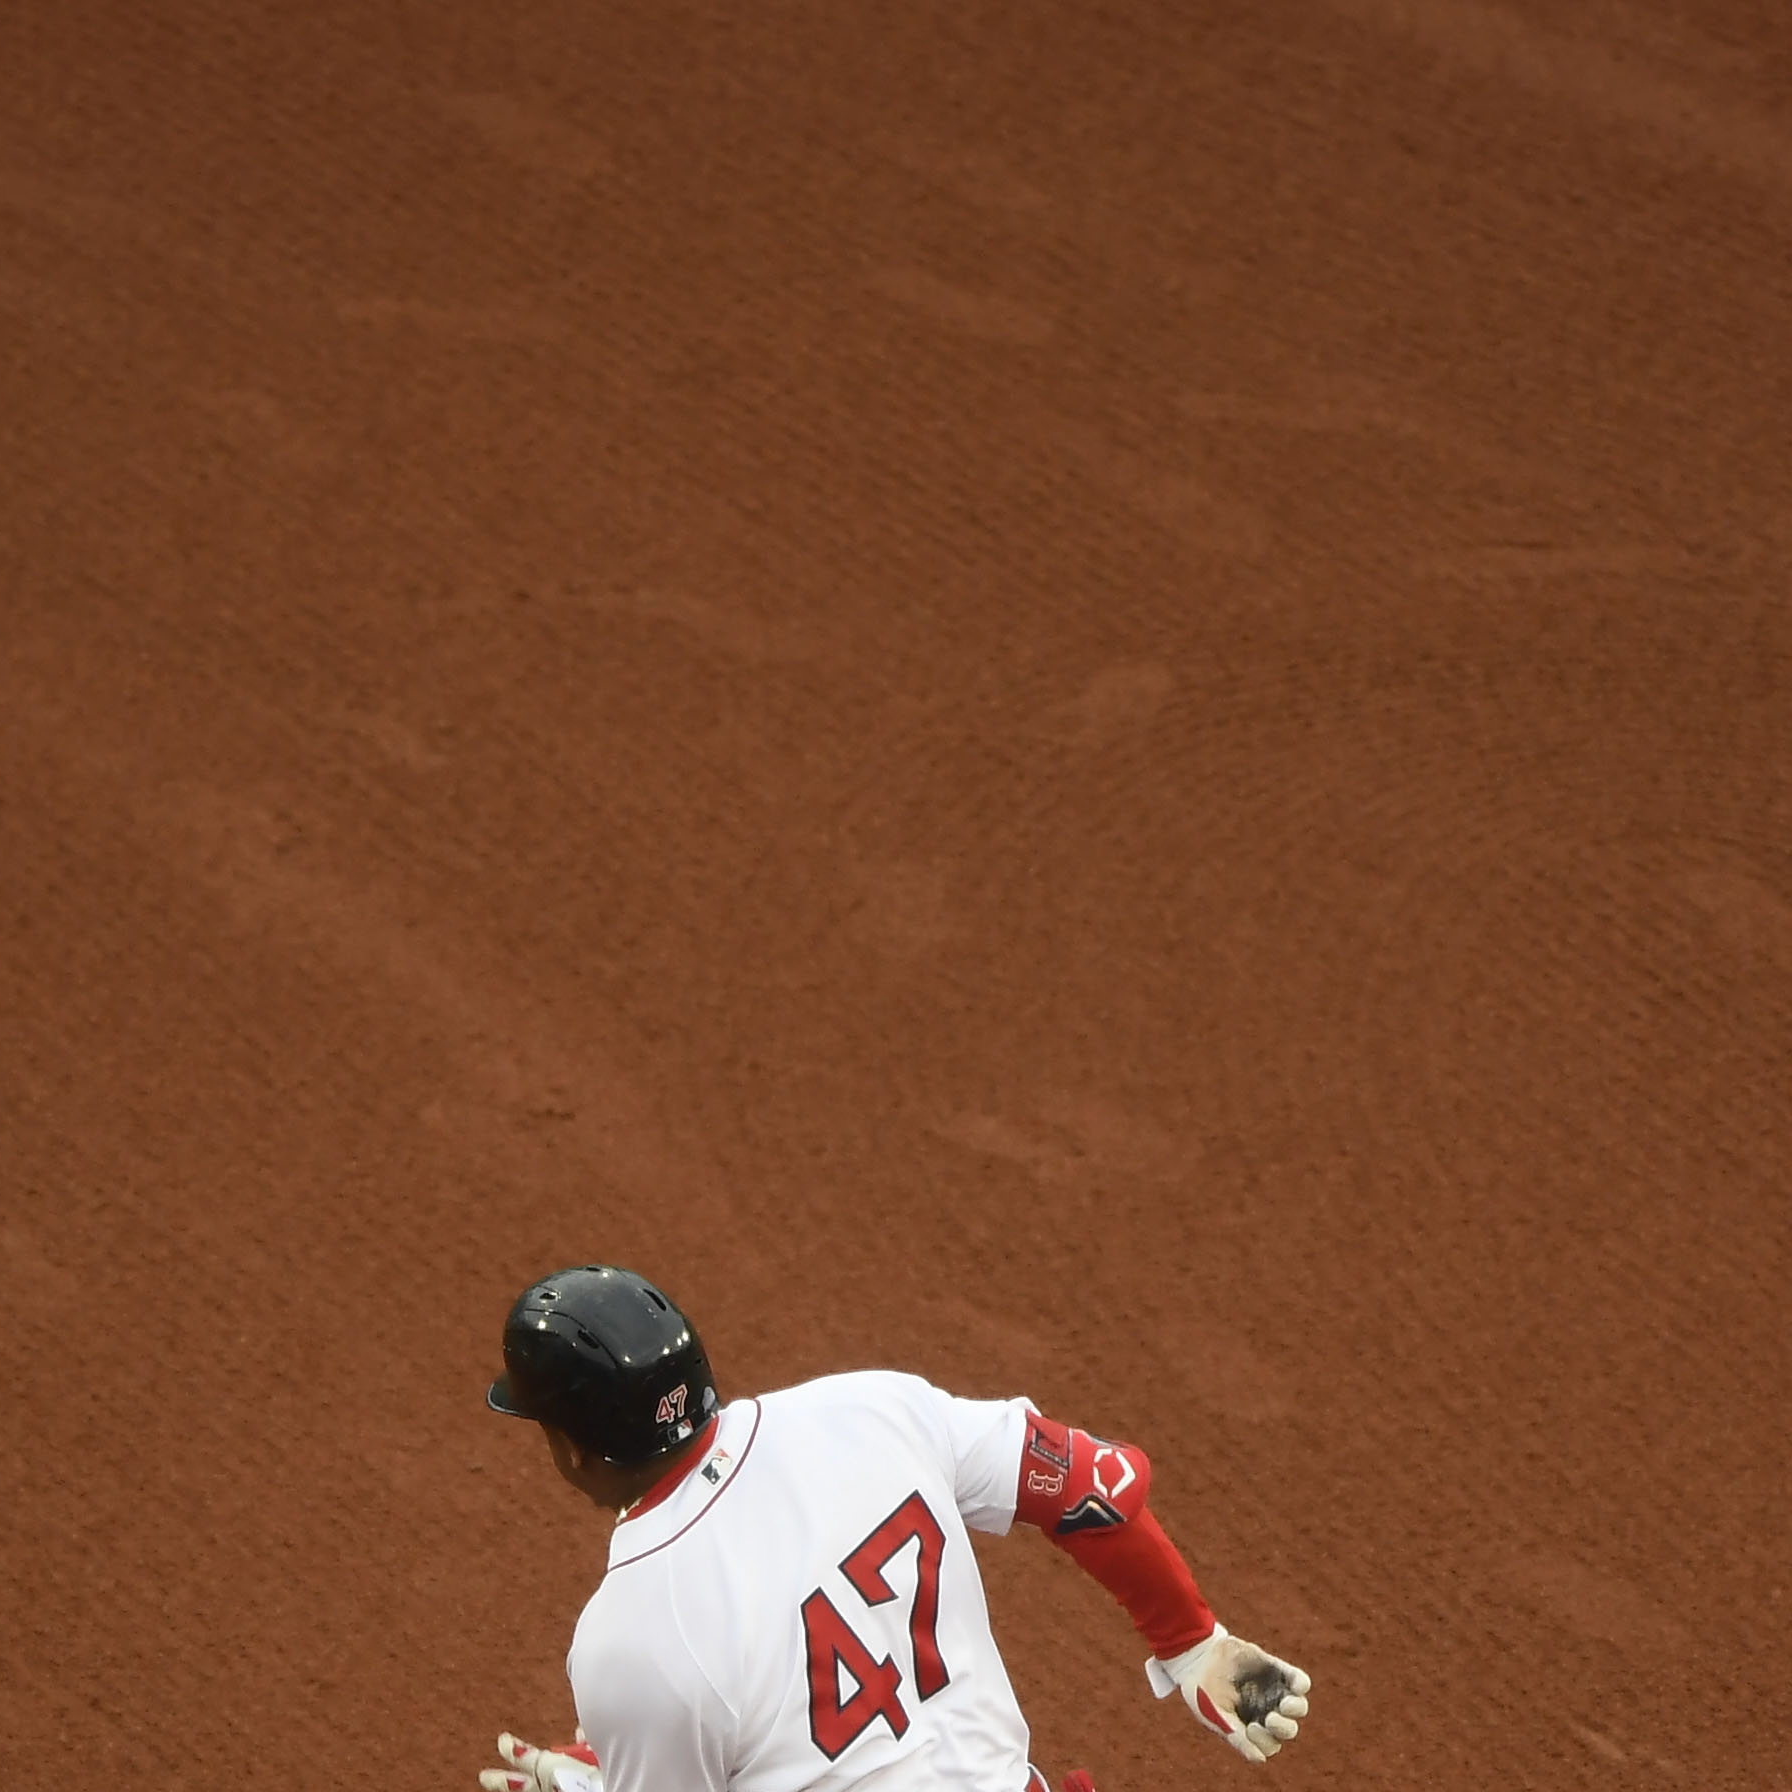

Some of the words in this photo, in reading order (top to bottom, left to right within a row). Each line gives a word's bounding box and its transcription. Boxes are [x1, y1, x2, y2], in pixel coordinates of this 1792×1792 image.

[656, 1384, 688, 1424] 47
[1028, 1470, 1064, 1496] B
[801, 1489, 951, 1763] 47
